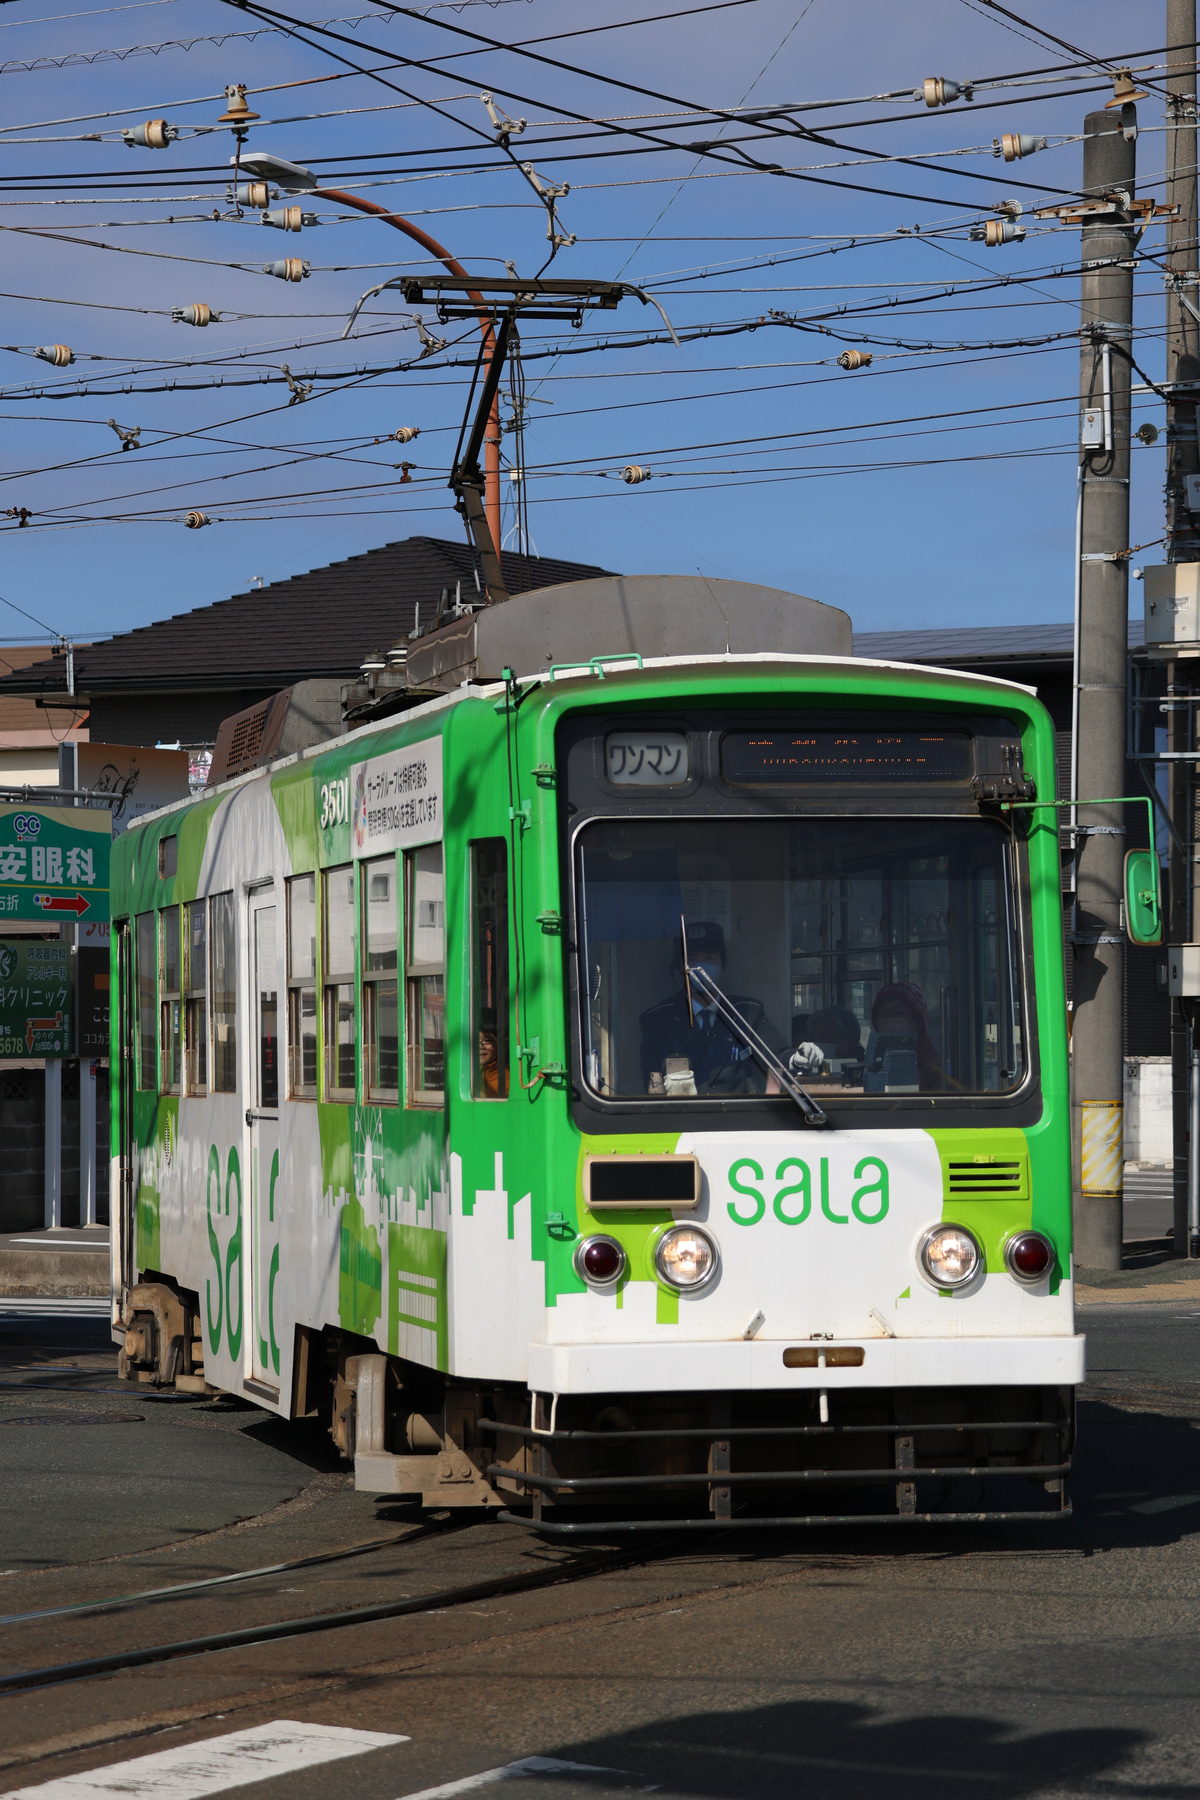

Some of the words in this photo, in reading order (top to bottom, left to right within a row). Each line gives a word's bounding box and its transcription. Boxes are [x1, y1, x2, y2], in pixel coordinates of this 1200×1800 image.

[609, 743, 682, 777] ワンマン
[320, 777, 349, 829] 3501
[0, 844, 96, 885] 安眼科
[27, 946, 66, 961] 呼吸器内科
[27, 965, 67, 981] アレルギー科
[0, 1037, 23, 1053] 5678
[727, 1156, 890, 1227] sala
